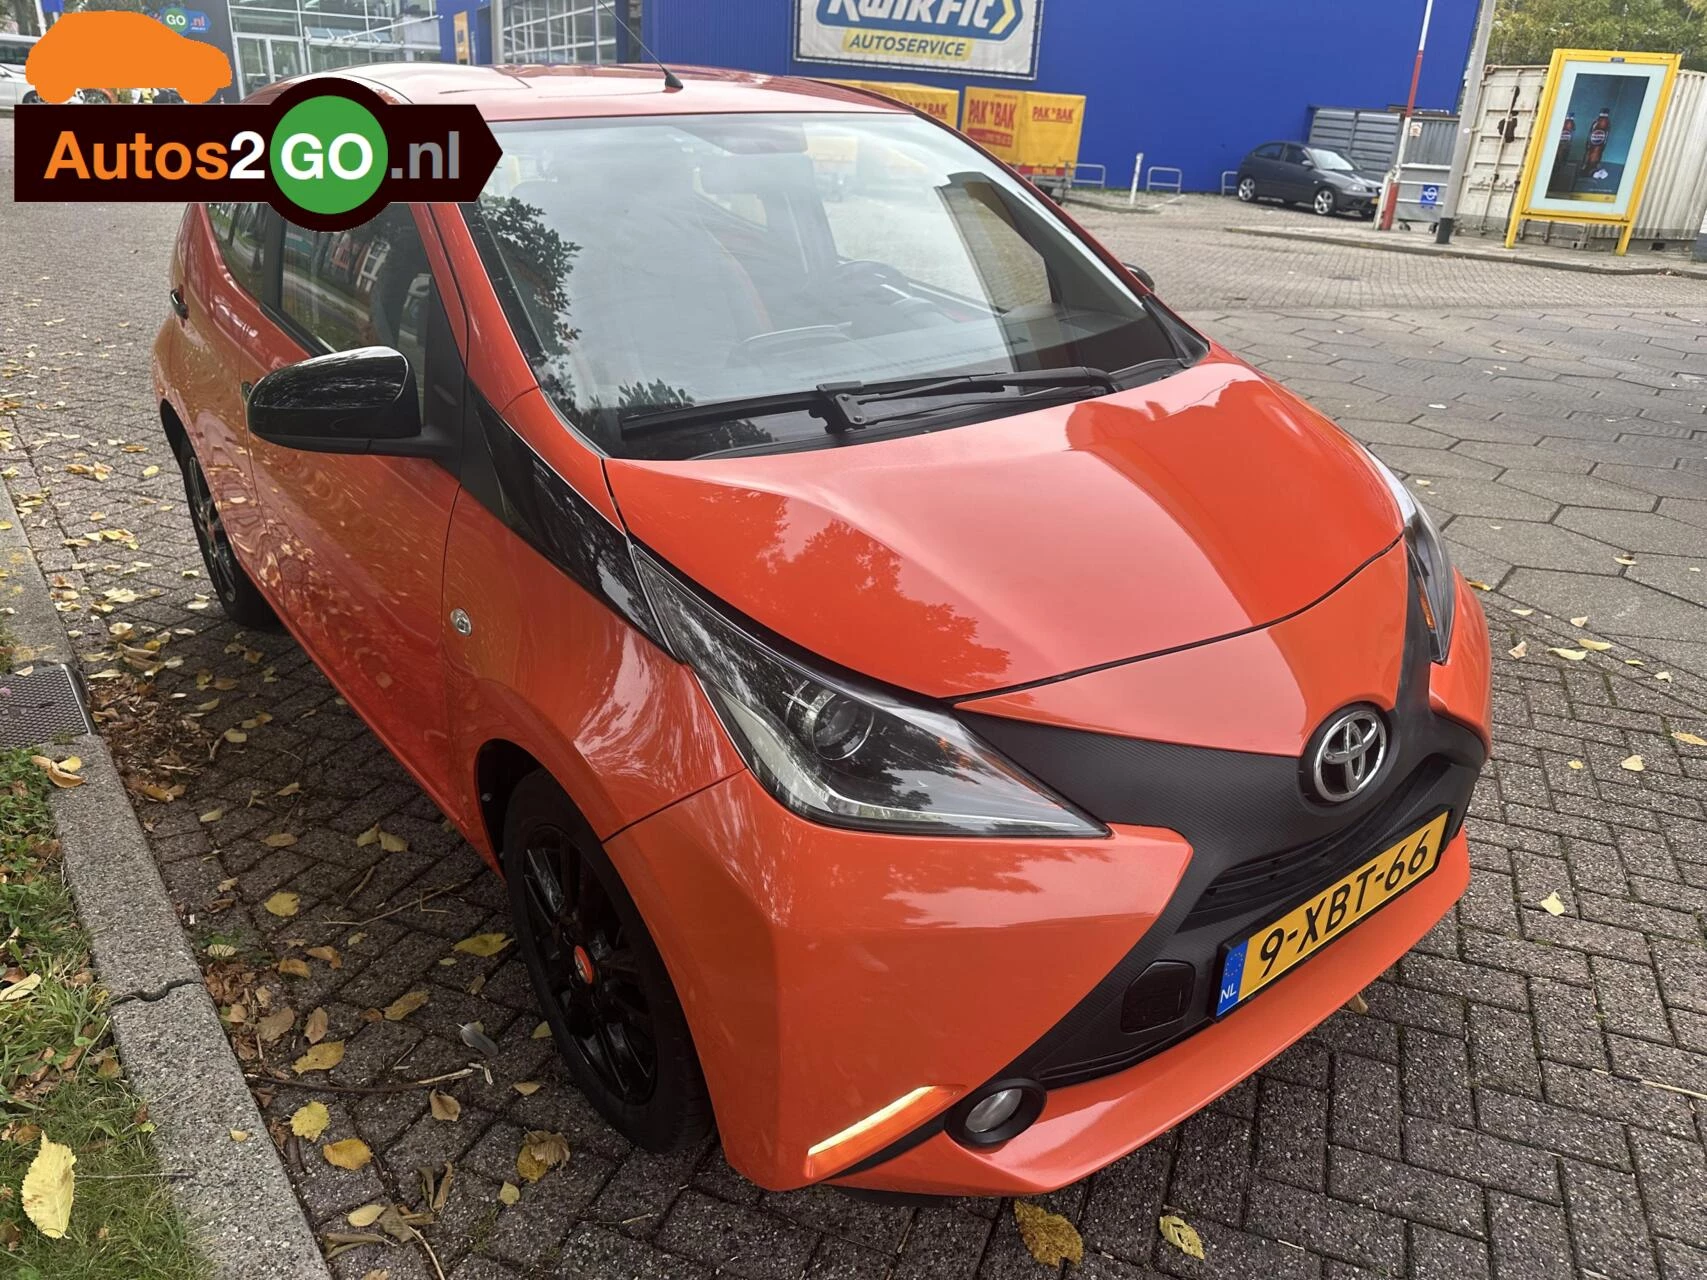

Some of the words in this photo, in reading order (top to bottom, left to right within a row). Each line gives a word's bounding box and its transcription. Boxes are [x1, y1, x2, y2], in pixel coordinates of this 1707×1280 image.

[849, 34, 966, 56] AUTOSERVICE
[1260, 830, 1430, 979] 9-XBT-66
[1220, 983, 1237, 1003] NL
